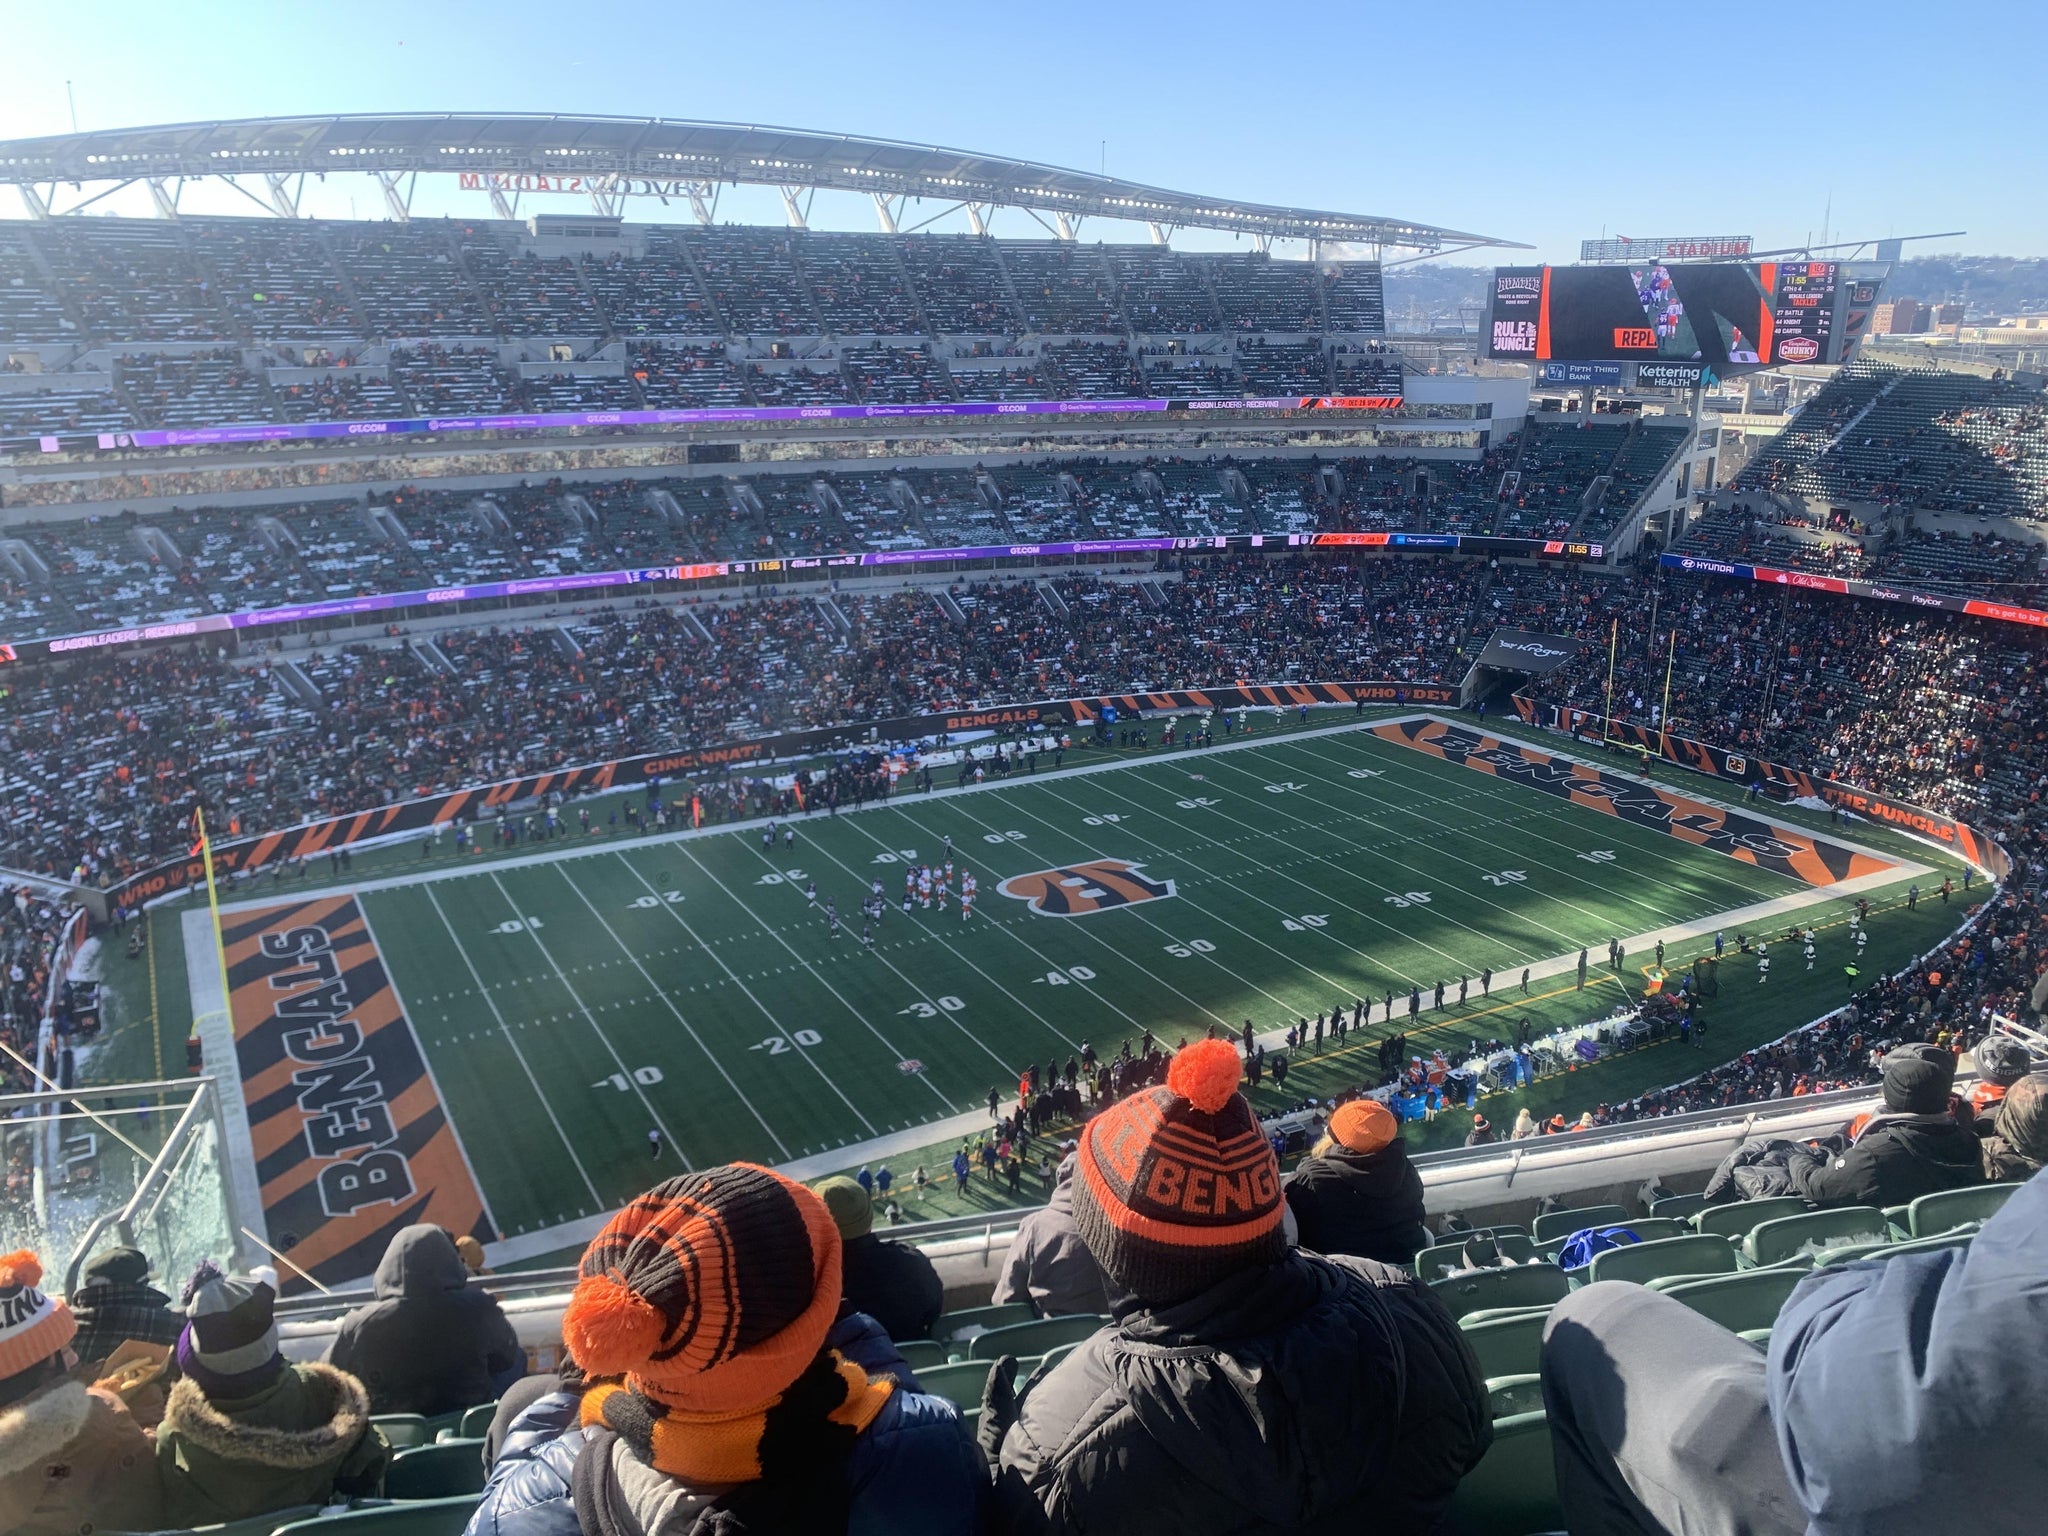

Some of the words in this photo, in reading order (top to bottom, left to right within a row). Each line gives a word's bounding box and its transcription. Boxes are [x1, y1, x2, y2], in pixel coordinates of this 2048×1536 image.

[1666, 242, 1749, 256] STADIUM
[1799, 265, 1807, 273] 14
[1829, 265, 1835, 273] 0
[1498, 276, 1541, 293] RUMPKE
[1787, 276, 1807, 285] 11:55
[1494, 321, 1527, 337] RULE
[1494, 337, 1536, 351] JUNGLE
[1781, 345, 1816, 356] CHUNKY
[1569, 365, 1592, 373] FIFTH
[1639, 365, 1700, 380] Kettering
[1569, 373, 1591, 381] BANK
[1654, 378, 1690, 387] HEALTH
[1188, 401, 1214, 409] SEASON
[1246, 400, 1279, 408] RECEIVING
[1010, 546, 1040, 554] GT.COM
[1568, 544, 1588, 554] 11:55
[758, 561, 781, 571] 11:55
[791, 559, 806, 568] 4TH
[845, 557, 856, 565] 32
[1696, 561, 1735, 574] HYUNDAI
[664, 568, 678, 579] 14
[1792, 575, 1807, 585] Old
[1806, 576, 1827, 588] Spice
[1871, 588, 1901, 600] Paycor
[1912, 595, 1943, 606] Paycor
[1987, 607, 2000, 616] It's
[2002, 609, 2016, 619] got
[2018, 611, 2028, 620] to
[2029, 613, 2041, 622] be
[49, 635, 93, 653] SEASON
[94, 629, 138, 646] LEADERS
[145, 622, 197, 639] RECEIVING
[1517, 643, 1567, 657] Kroger
[1354, 687, 1396, 699] WHO
[1412, 688, 1452, 701] DEY
[946, 707, 1039, 729] BENGALS
[1728, 758, 1744, 772] 23
[1420, 734, 1809, 858] BENGALS
[1823, 788, 1867, 811] THE
[1869, 802, 1955, 842] JUNGLE
[1575, 850, 1613, 864] 10
[1482, 870, 1524, 887] 20
[117, 876, 166, 907] WHO
[1384, 891, 1428, 908] 30
[1281, 914, 1327, 933] 40
[1163, 938, 1217, 959] 50
[1043, 965, 1097, 989] 40
[909, 995, 966, 1020] 30
[761, 1028, 825, 1056] 20
[258, 924, 417, 1217] BENGALS
[608, 1065, 665, 1092] 10
